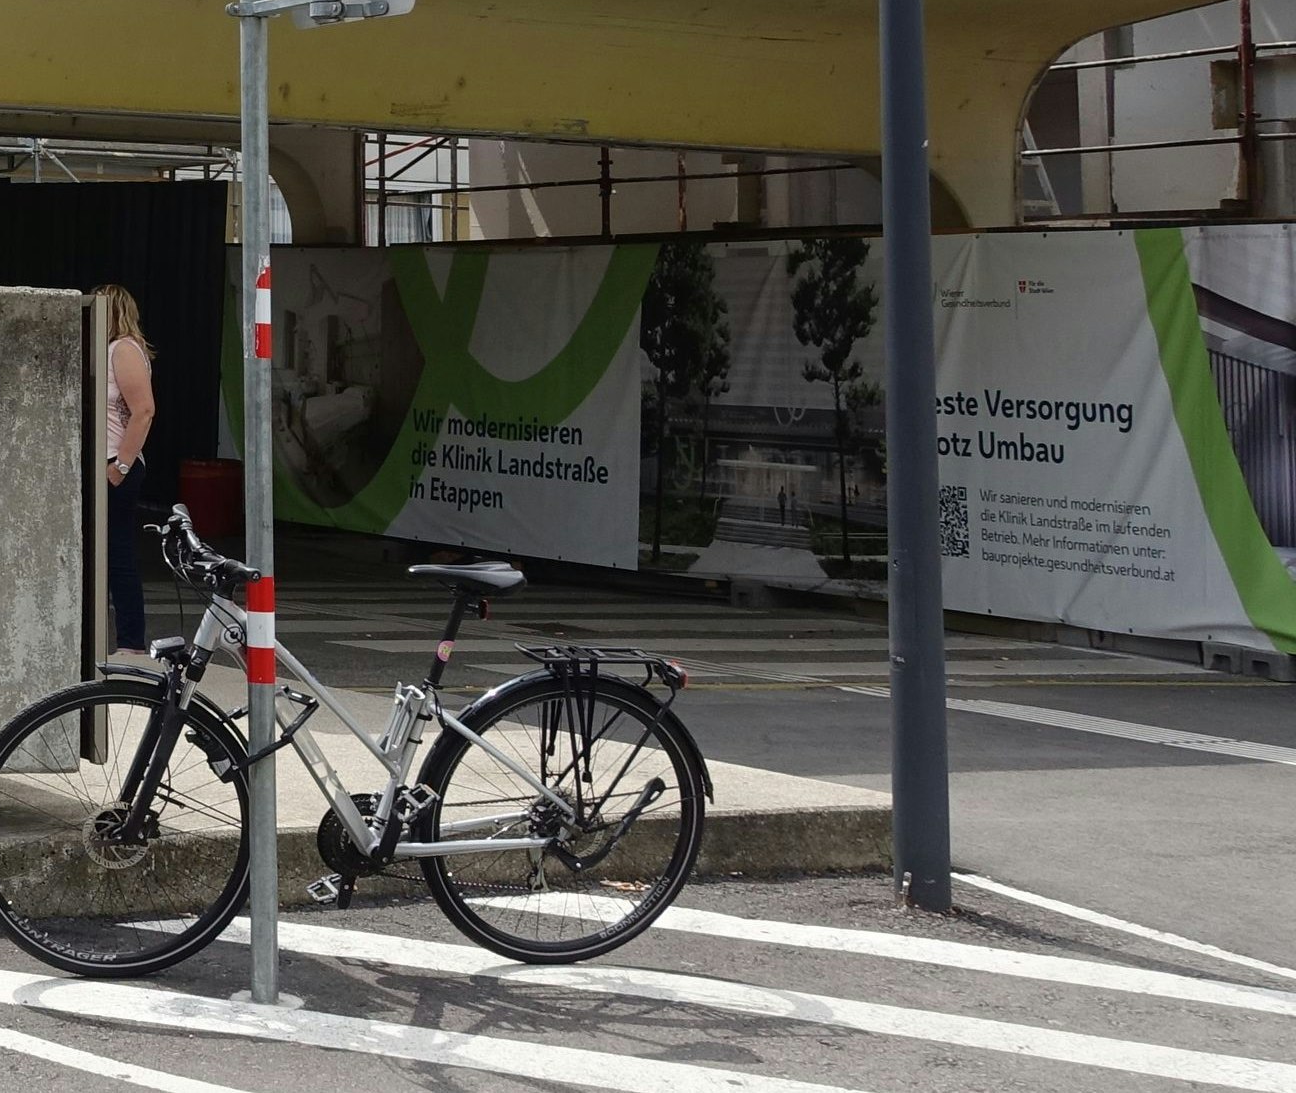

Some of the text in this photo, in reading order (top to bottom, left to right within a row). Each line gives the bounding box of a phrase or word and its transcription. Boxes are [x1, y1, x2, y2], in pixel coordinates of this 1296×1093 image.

[413, 408, 582, 445] Wir modernisieren
[984, 389, 1133, 433] Versorgung
[411, 442, 608, 484] die Klinik Landstraße
[978, 431, 1065, 464] Umbau
[409, 475, 503, 512] in Etappen
[979, 489, 1151, 516] Wir sanieren und modernisieren
[980, 510, 1171, 538] die Klinik Landstraße im laufenden
[981, 528, 1166, 559] Betrieb. Mehr Informationen unter:
[981, 548, 1175, 582] bauprojekte.gesundheitsverbund.at
[607, 876, 671, 936] CONNECTION
[8, 909, 117, 962] BONTRAGER
